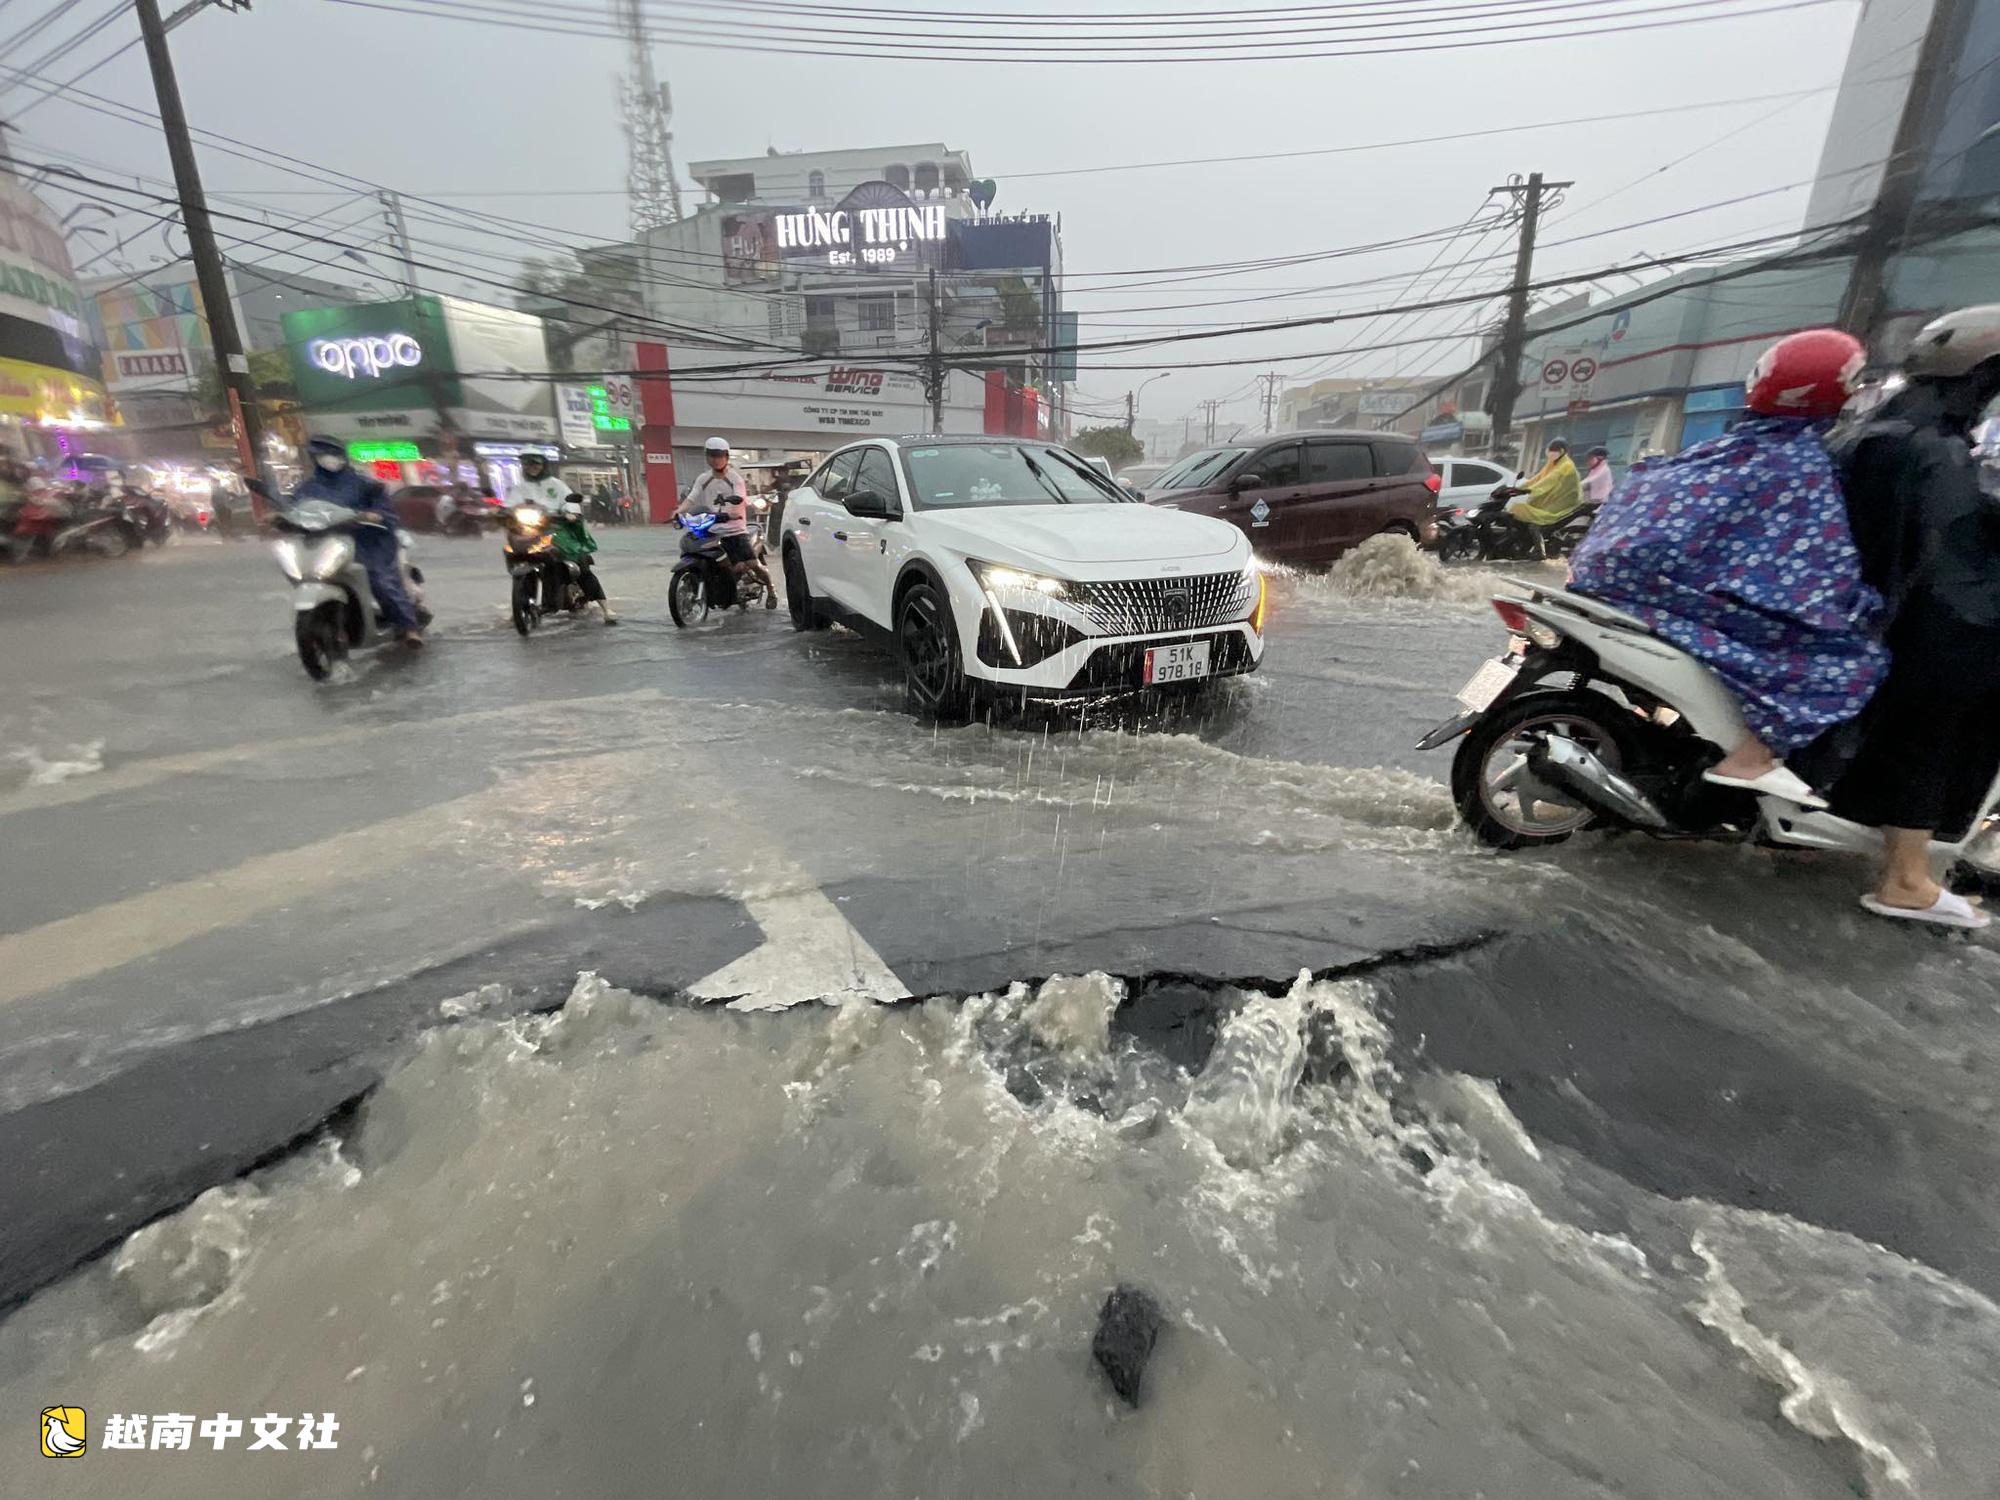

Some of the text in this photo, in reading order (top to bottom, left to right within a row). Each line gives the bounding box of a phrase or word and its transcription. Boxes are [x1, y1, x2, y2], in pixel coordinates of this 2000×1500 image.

[775, 206, 946, 251] HƯNG THỊNH
[829, 248, 896, 265] Est. 1989
[1170, 647, 1194, 663] 51K
